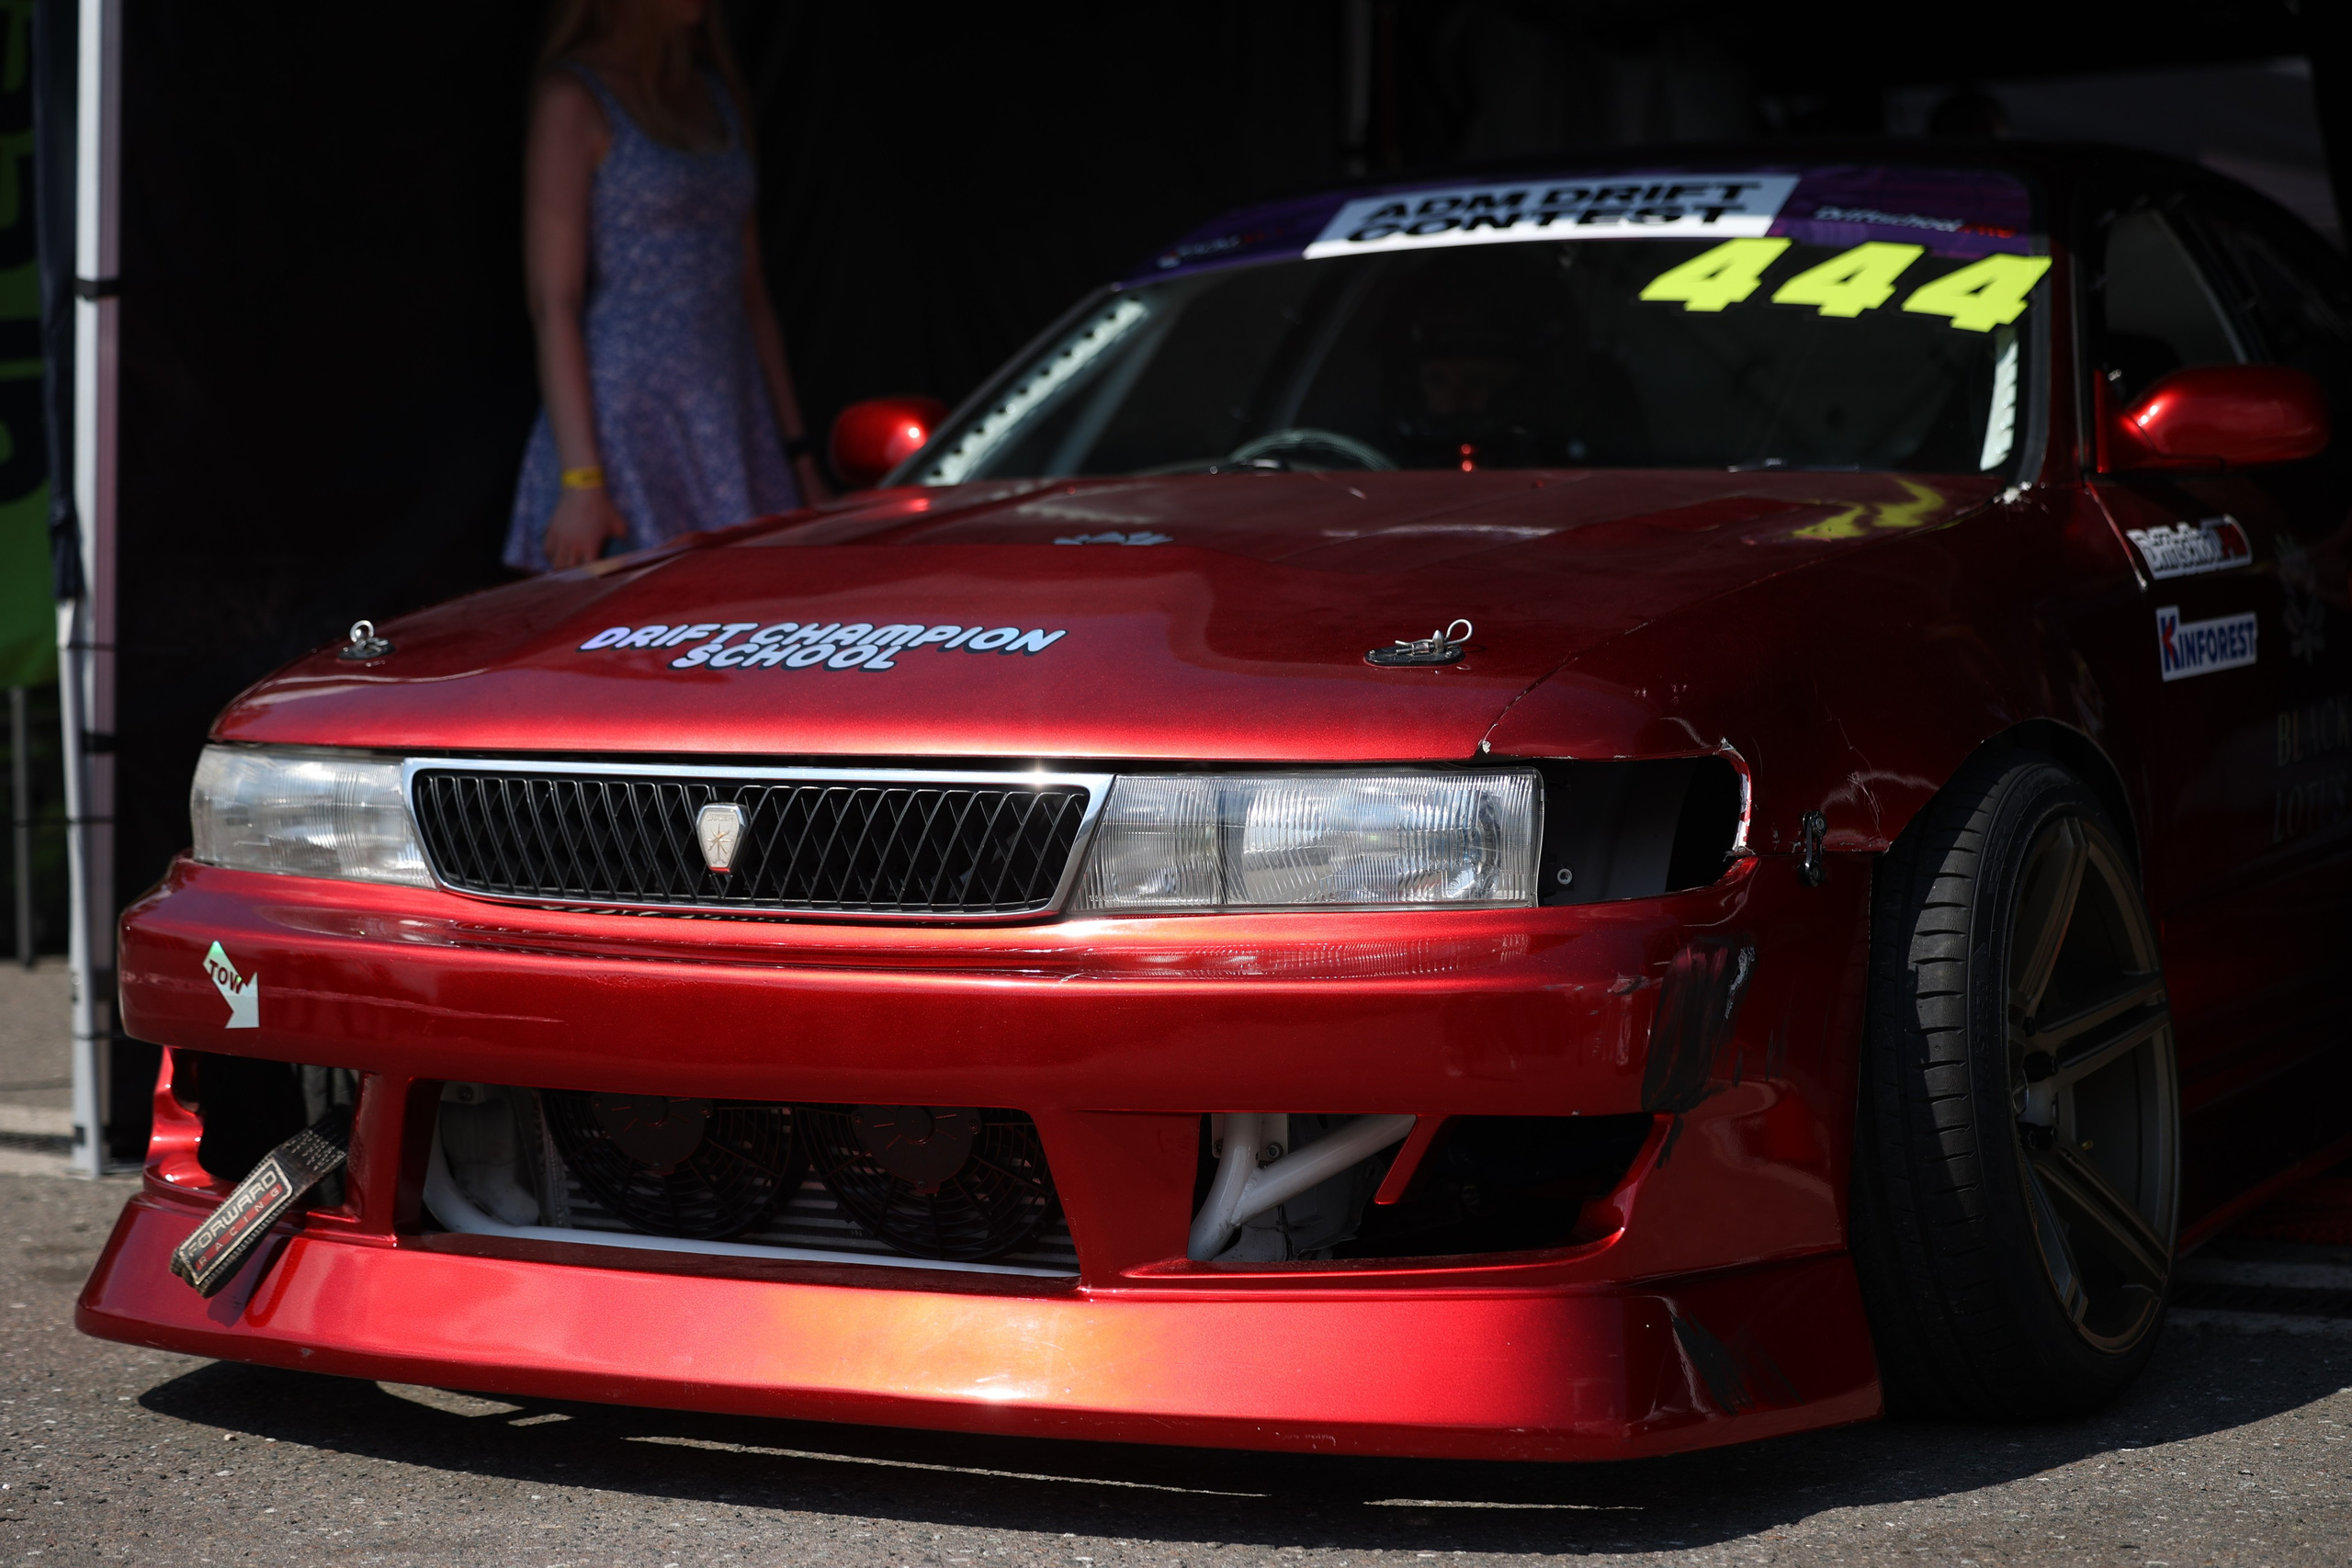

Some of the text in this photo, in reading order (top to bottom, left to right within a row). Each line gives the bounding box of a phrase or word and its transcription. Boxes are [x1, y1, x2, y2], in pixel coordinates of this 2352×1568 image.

[1347, 204, 1748, 242] CONTEST
[1363, 181, 1761, 223] ADM DRIFT
[1638, 237, 2053, 333] 444
[579, 623, 1068, 655] DRIFT CHAMPION
[669, 643, 902, 671] SCHOOL
[2161, 615, 2256, 672] KINFOREST
[208, 959, 244, 995] TOW
[187, 1168, 278, 1258] FORWARD
[196, 1185, 282, 1268] RACING
